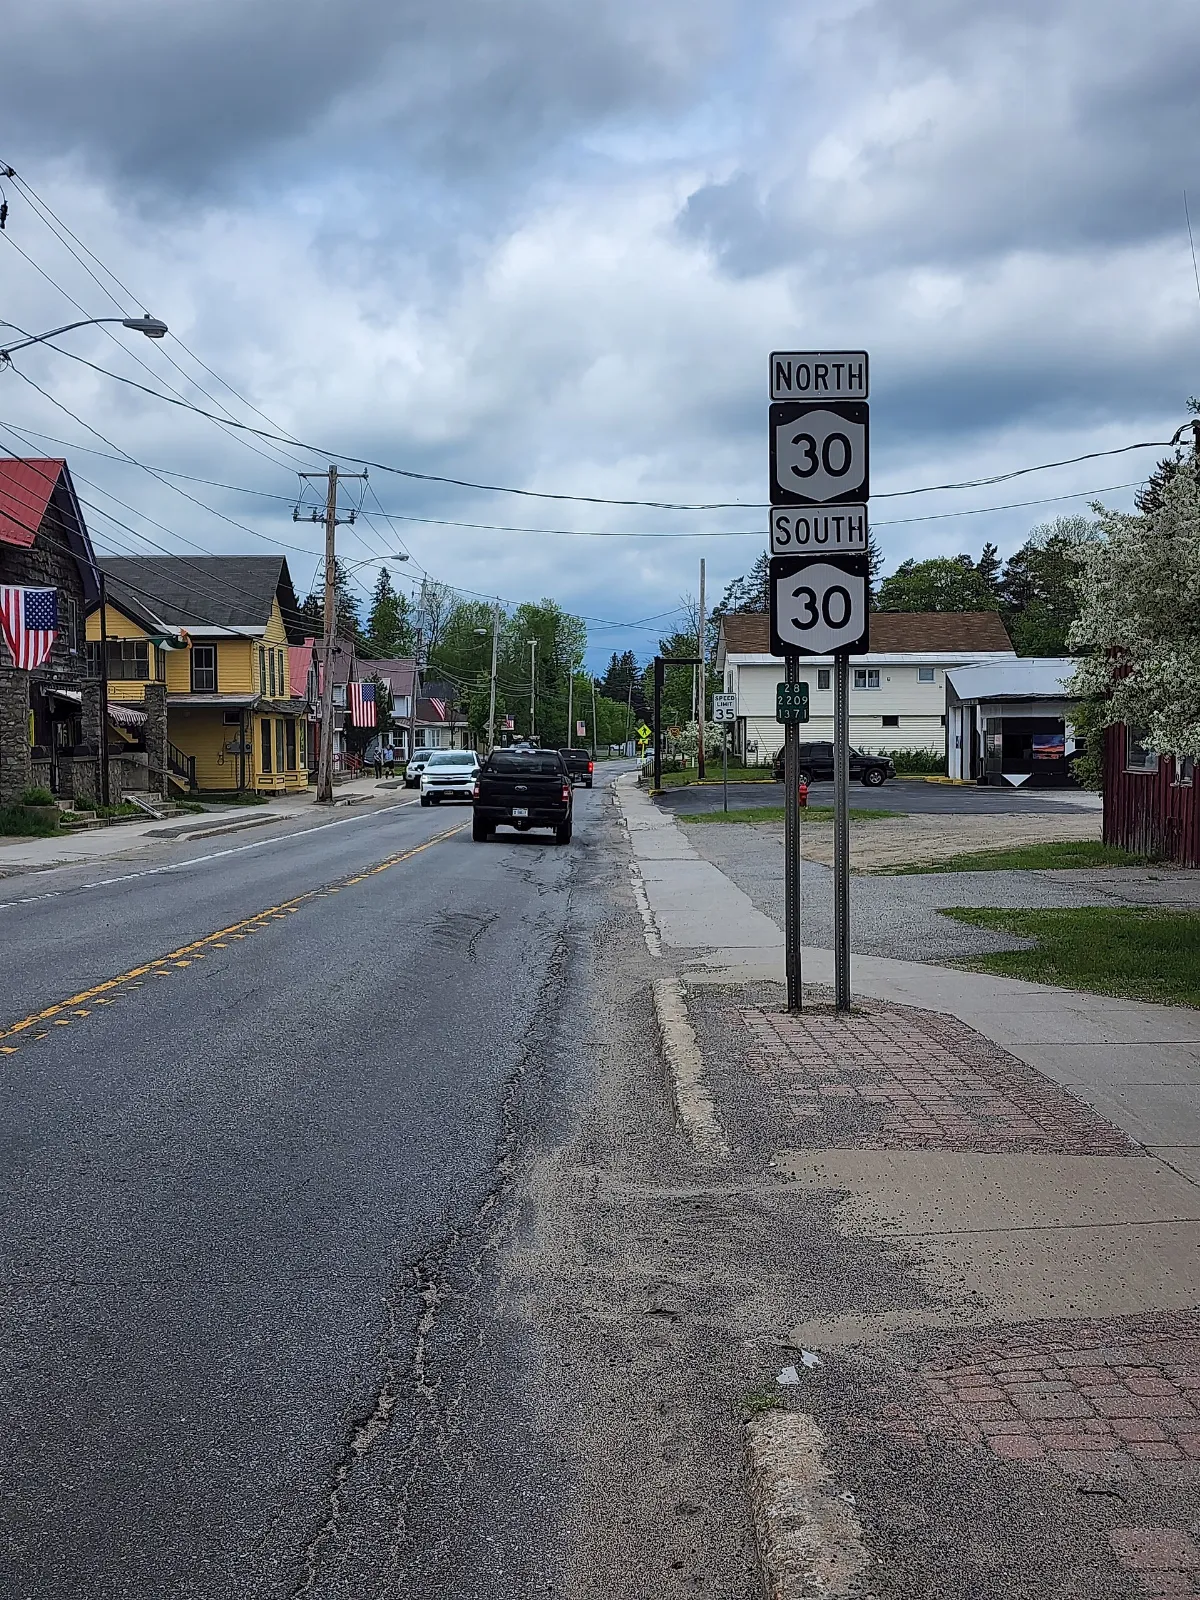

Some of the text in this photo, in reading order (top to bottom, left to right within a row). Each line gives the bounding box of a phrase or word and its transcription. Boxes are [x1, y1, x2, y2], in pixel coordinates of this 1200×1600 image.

[776, 361, 863, 391] NORTH
[790, 432, 852, 478] 30
[775, 515, 863, 546] SOUTH
[790, 585, 852, 631] 30
[784, 683, 800, 693] 28
[778, 696, 808, 705] 2209
[716, 709, 734, 719] 35
[778, 709, 806, 718] 1371
